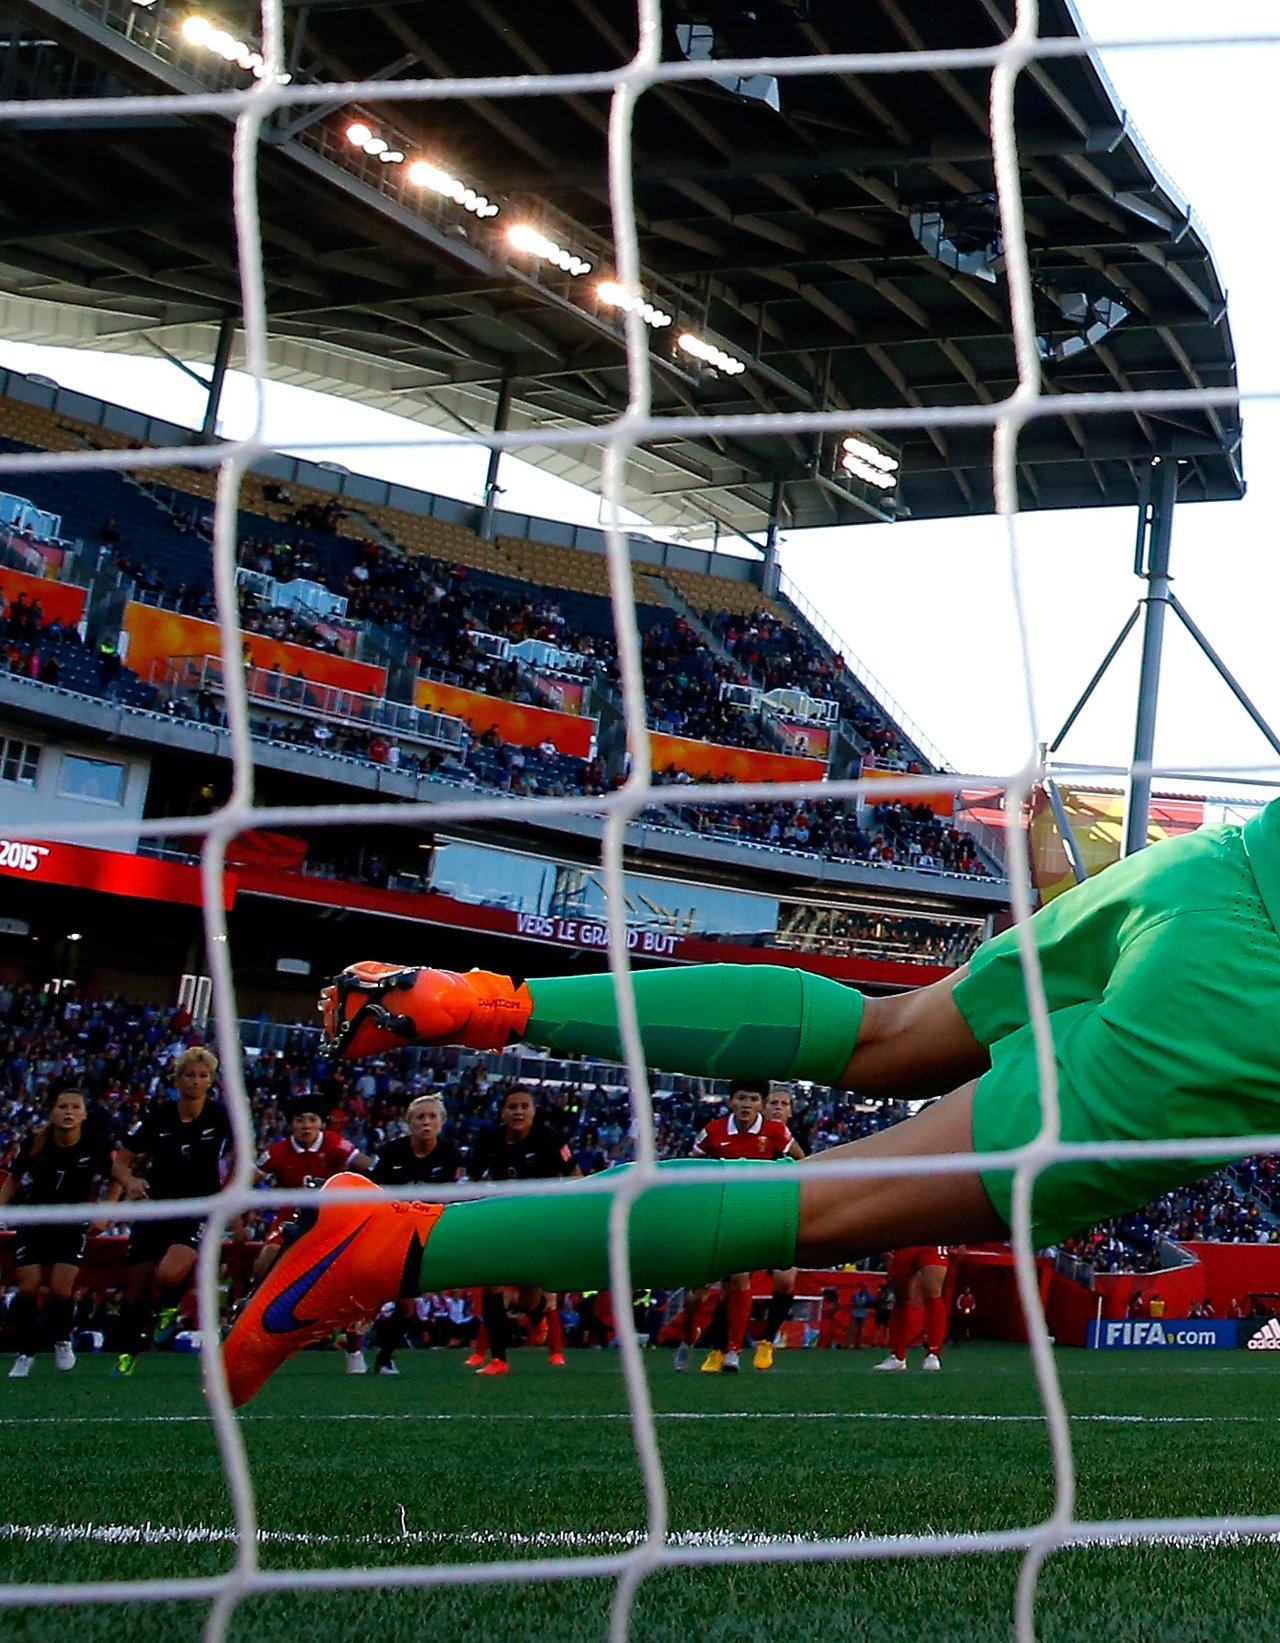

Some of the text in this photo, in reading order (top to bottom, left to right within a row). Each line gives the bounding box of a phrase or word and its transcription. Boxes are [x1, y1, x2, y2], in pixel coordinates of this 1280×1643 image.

[516, 913, 554, 937] VERS
[557, 920, 577, 942] LE
[580, 924, 639, 948] GRAD
[56, 1170, 65, 1190] 7
